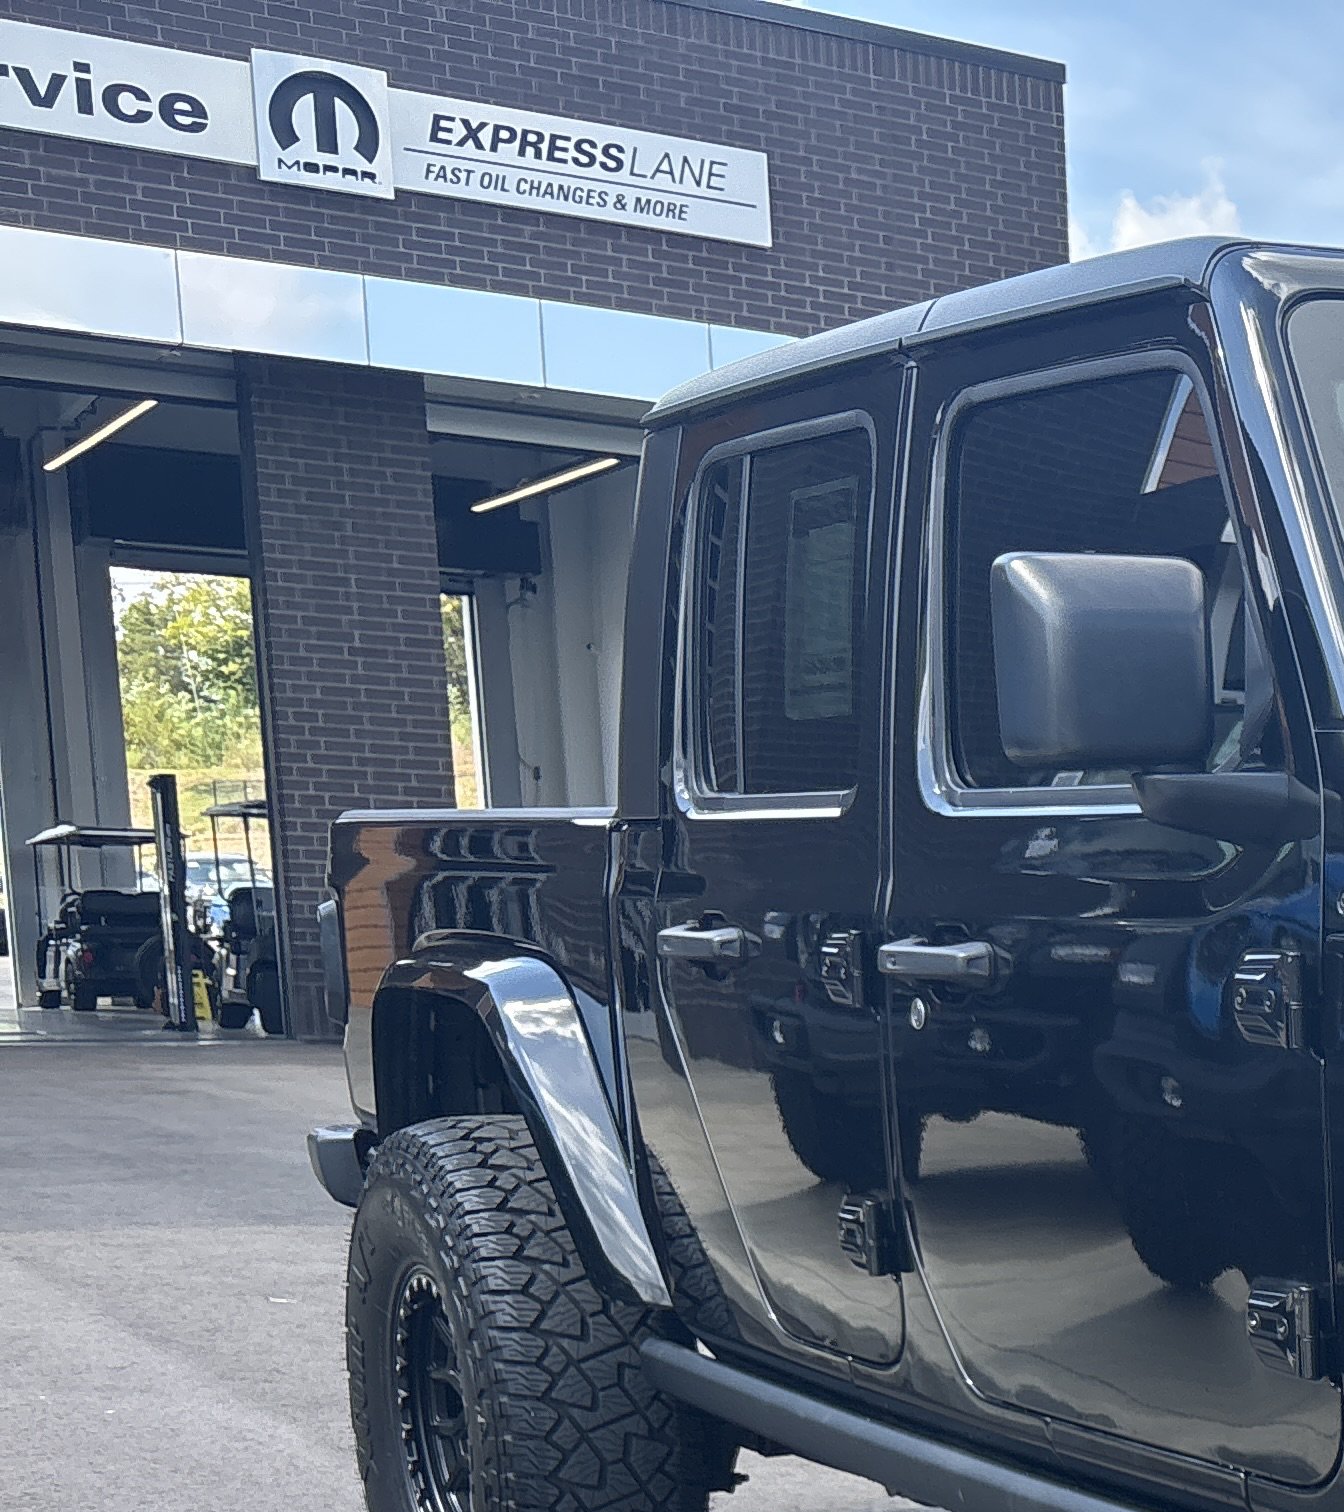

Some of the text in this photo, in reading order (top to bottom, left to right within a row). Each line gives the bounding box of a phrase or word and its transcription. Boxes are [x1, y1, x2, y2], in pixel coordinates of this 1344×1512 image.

[277, 157, 380, 185] MOPAR
[429, 112, 729, 192] EXPRESSLANE
[424, 162, 690, 221] FAST OIL CHANGES & MORE
